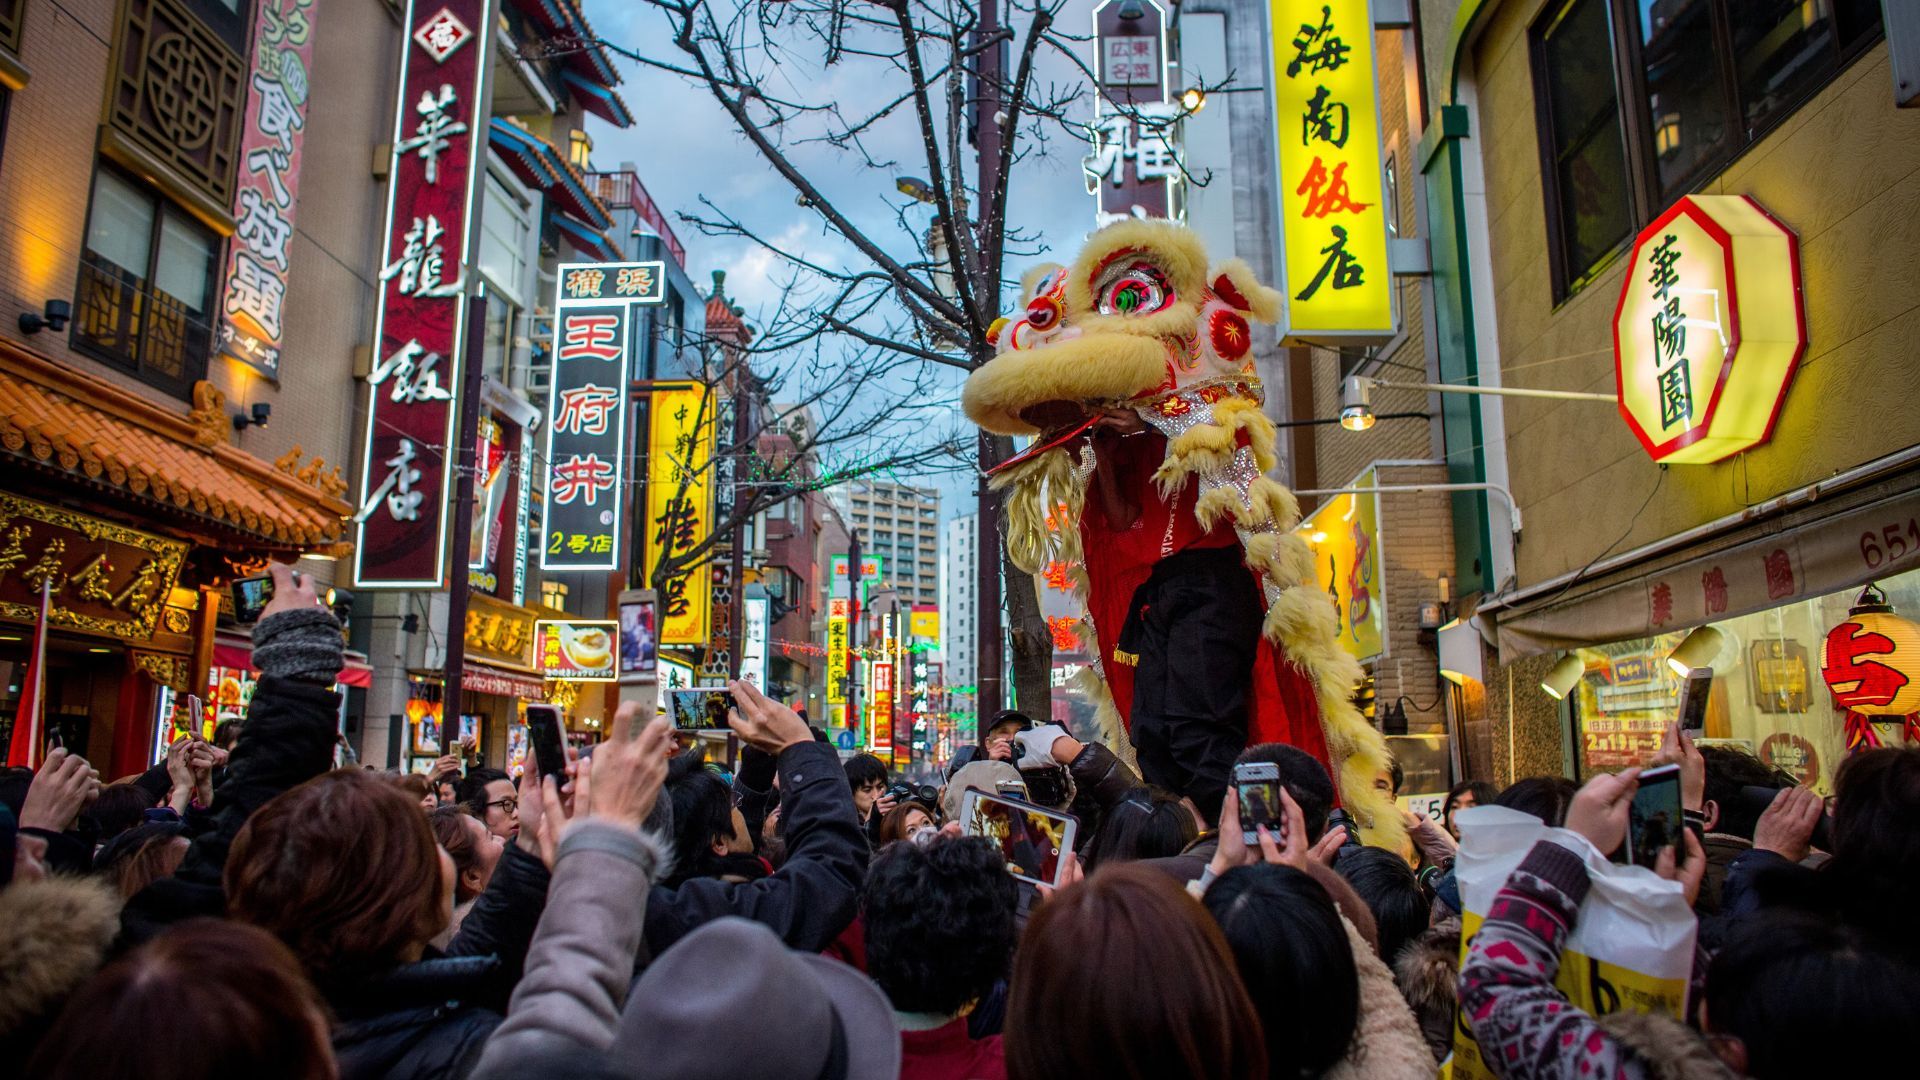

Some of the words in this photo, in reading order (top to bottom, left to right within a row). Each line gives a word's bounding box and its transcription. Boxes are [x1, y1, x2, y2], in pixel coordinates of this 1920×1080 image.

[1111, 41, 1150, 58] 広東
[1111, 63, 1150, 80] 名菜
[225, 71, 304, 343] 食べ放題
[1286, 5, 1376, 302] 海南飯店
[354, 83, 470, 523] 華龍飯店
[565, 267, 655, 298] 横浜
[1648, 233, 1695, 432] 華陽園
[550, 314, 622, 506] 王府井
[548, 531, 613, 556] 2号店
